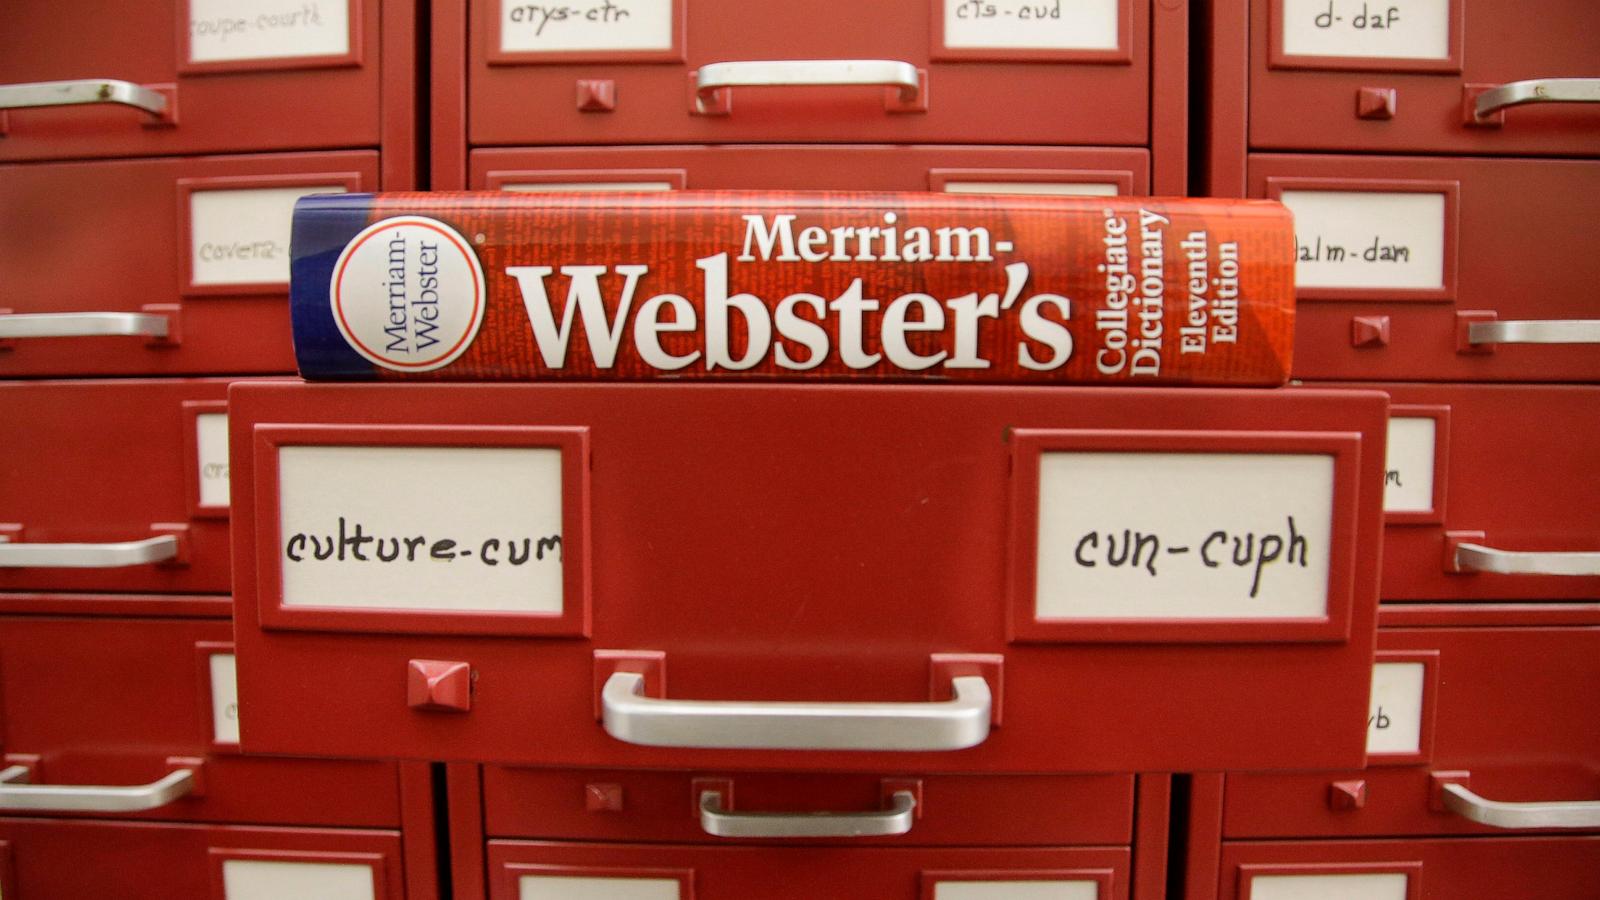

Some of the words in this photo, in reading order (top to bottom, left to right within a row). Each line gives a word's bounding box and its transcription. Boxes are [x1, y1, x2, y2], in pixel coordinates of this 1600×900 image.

[381, 231, 410, 355] Merriam-
[737, 210, 1014, 263] Merriam-
[1129, 207, 1170, 378] Dictionary
[1179, 230, 1209, 355] Eleventh
[1210, 241, 1239, 345] Edition
[411, 240, 441, 353] Webster
[505, 251, 1074, 371] Webster's
[286, 516, 563, 566] culture-cum
[1075, 515, 1308, 599] cun-cuph
